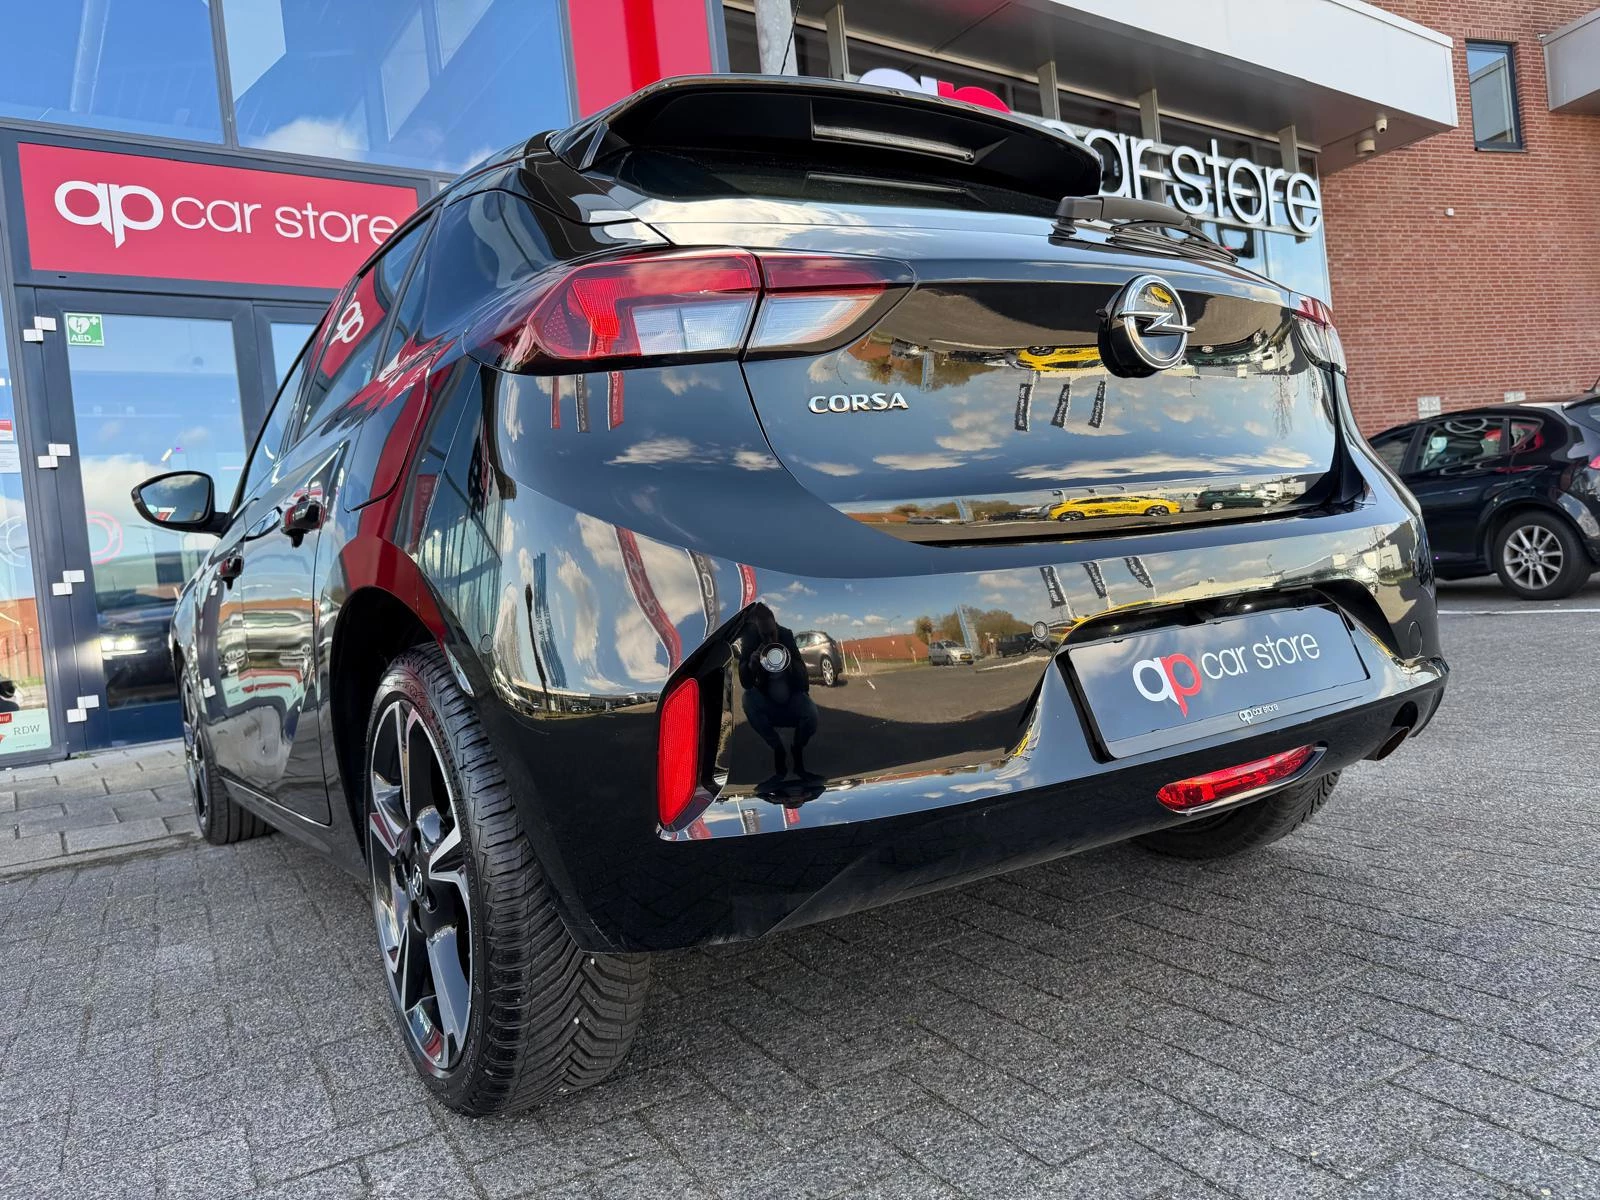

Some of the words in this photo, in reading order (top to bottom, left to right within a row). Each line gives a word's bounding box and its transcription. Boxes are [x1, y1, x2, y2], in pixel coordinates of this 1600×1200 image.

[1041, 119, 1153, 198] ar
[1171, 138, 1321, 233] store
[55, 180, 164, 248] ap
[171, 196, 262, 234] car
[275, 202, 398, 245] store
[71, 334, 92, 343] AED
[808, 392, 909, 414] CORSA
[1133, 654, 1202, 717] ap
[1202, 647, 1248, 680] car
[1254, 633, 1320, 670] store
[13, 724, 41, 736] RDW
